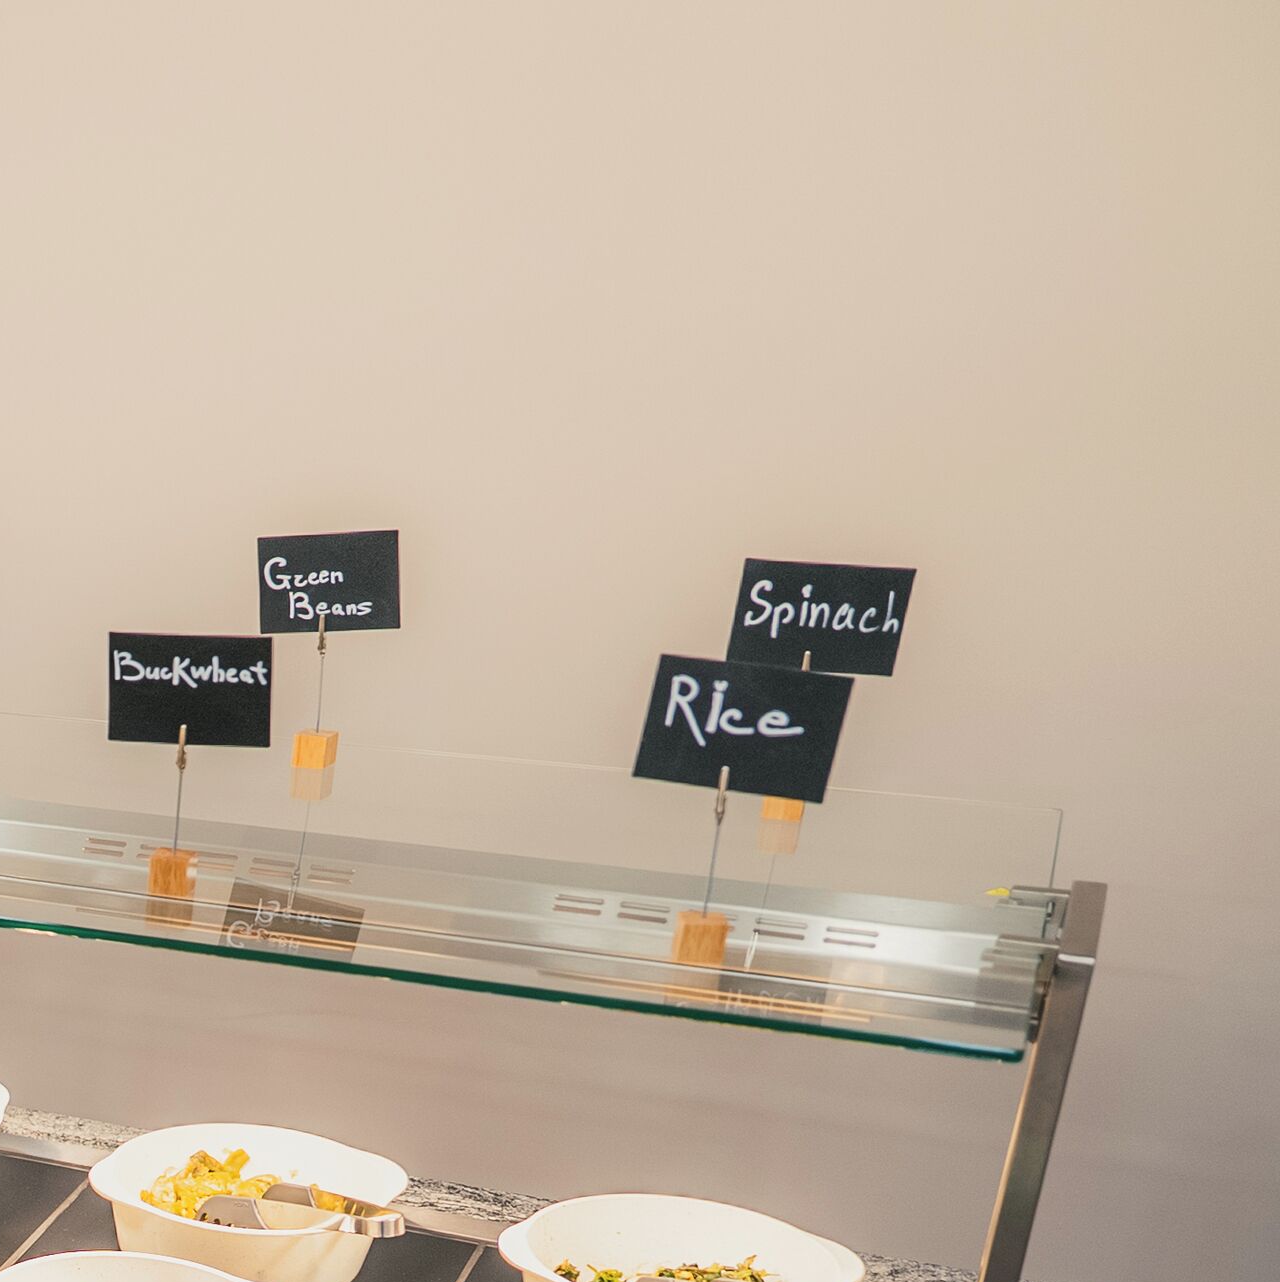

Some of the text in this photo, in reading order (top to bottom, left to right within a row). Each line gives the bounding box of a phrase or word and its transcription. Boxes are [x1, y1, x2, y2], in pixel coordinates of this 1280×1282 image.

[263, 556, 344, 590] Green
[288, 592, 373, 620] Beans
[742, 578, 900, 639] Spinach
[663, 675, 804, 747] Rice
